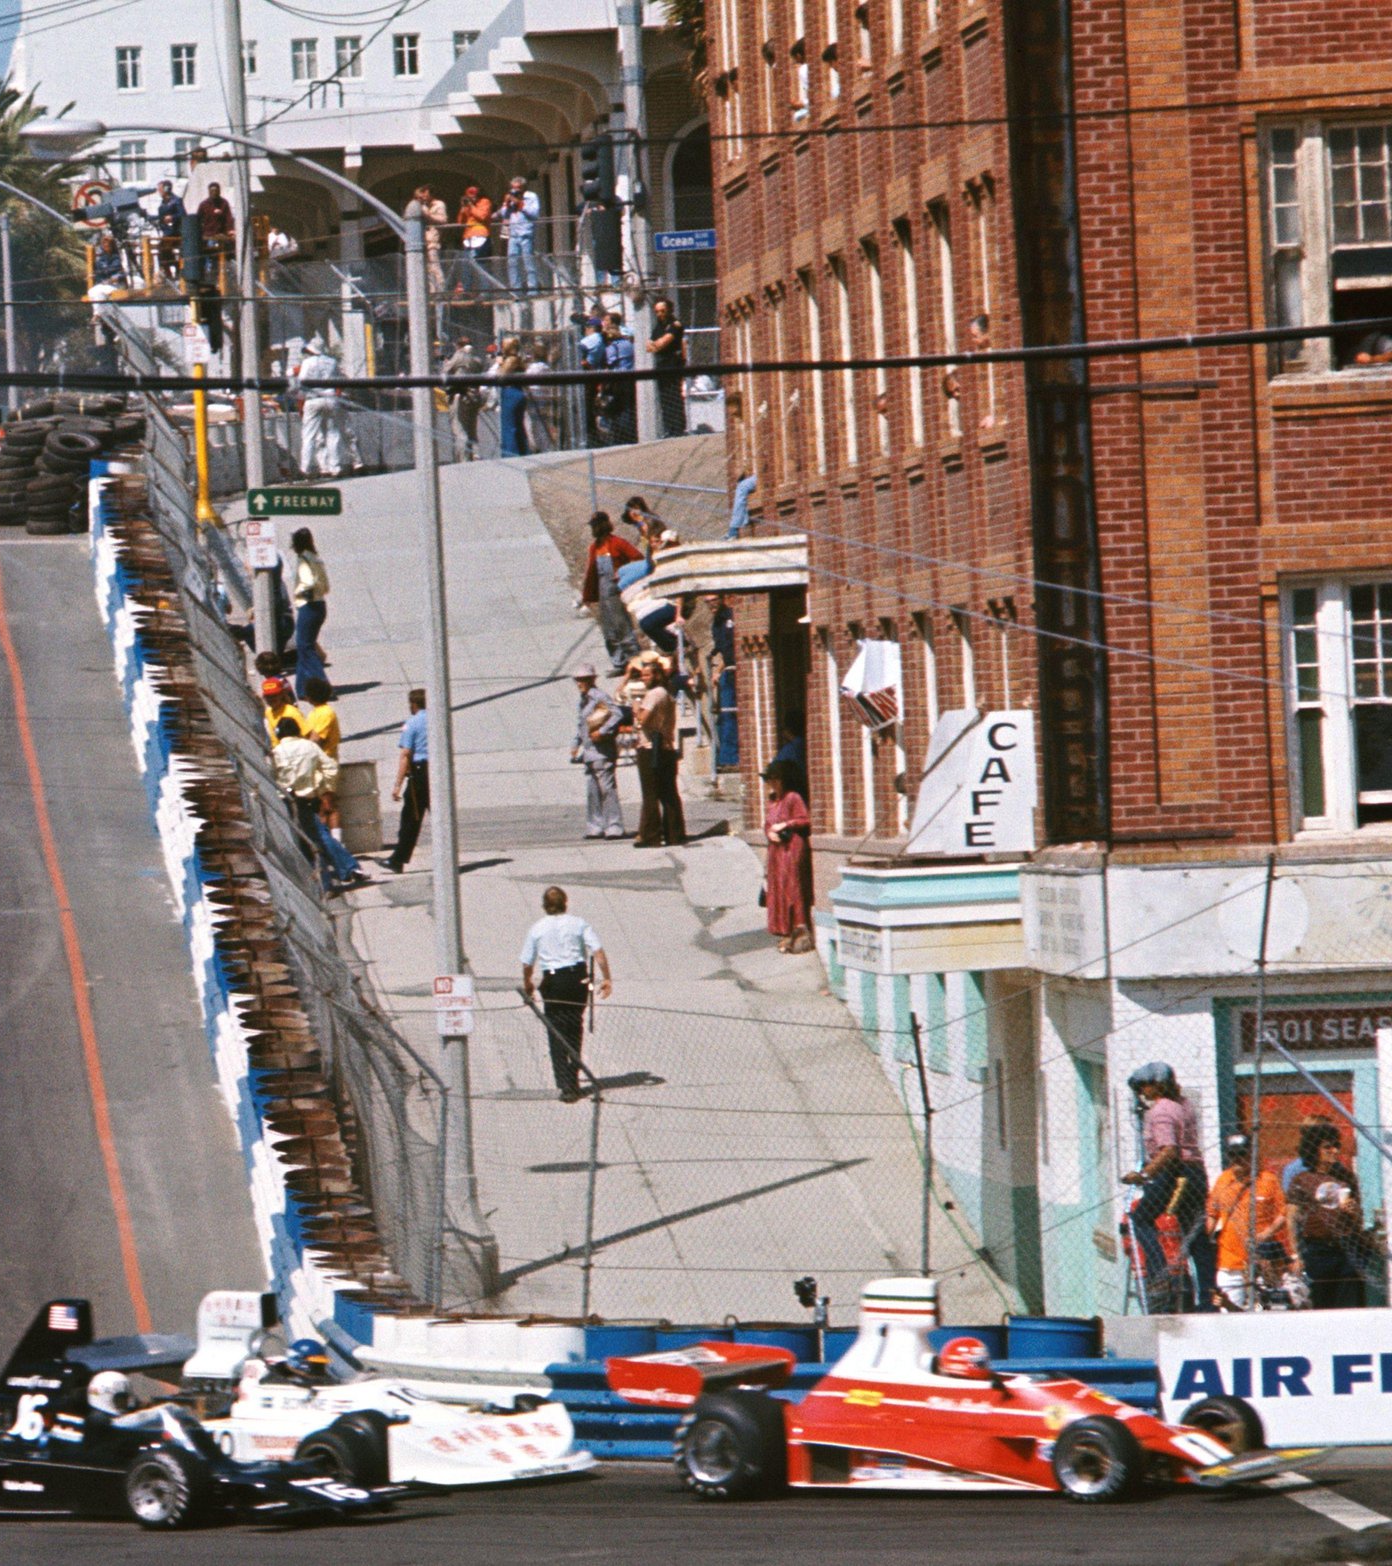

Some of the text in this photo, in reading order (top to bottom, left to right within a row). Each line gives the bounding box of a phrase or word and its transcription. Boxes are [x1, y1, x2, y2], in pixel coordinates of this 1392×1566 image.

[661, 235, 695, 248] Ocean
[272, 495, 335, 508] FREEWAY
[965, 722, 1017, 847] CAFE
[1172, 1356, 1313, 1400] AIR
